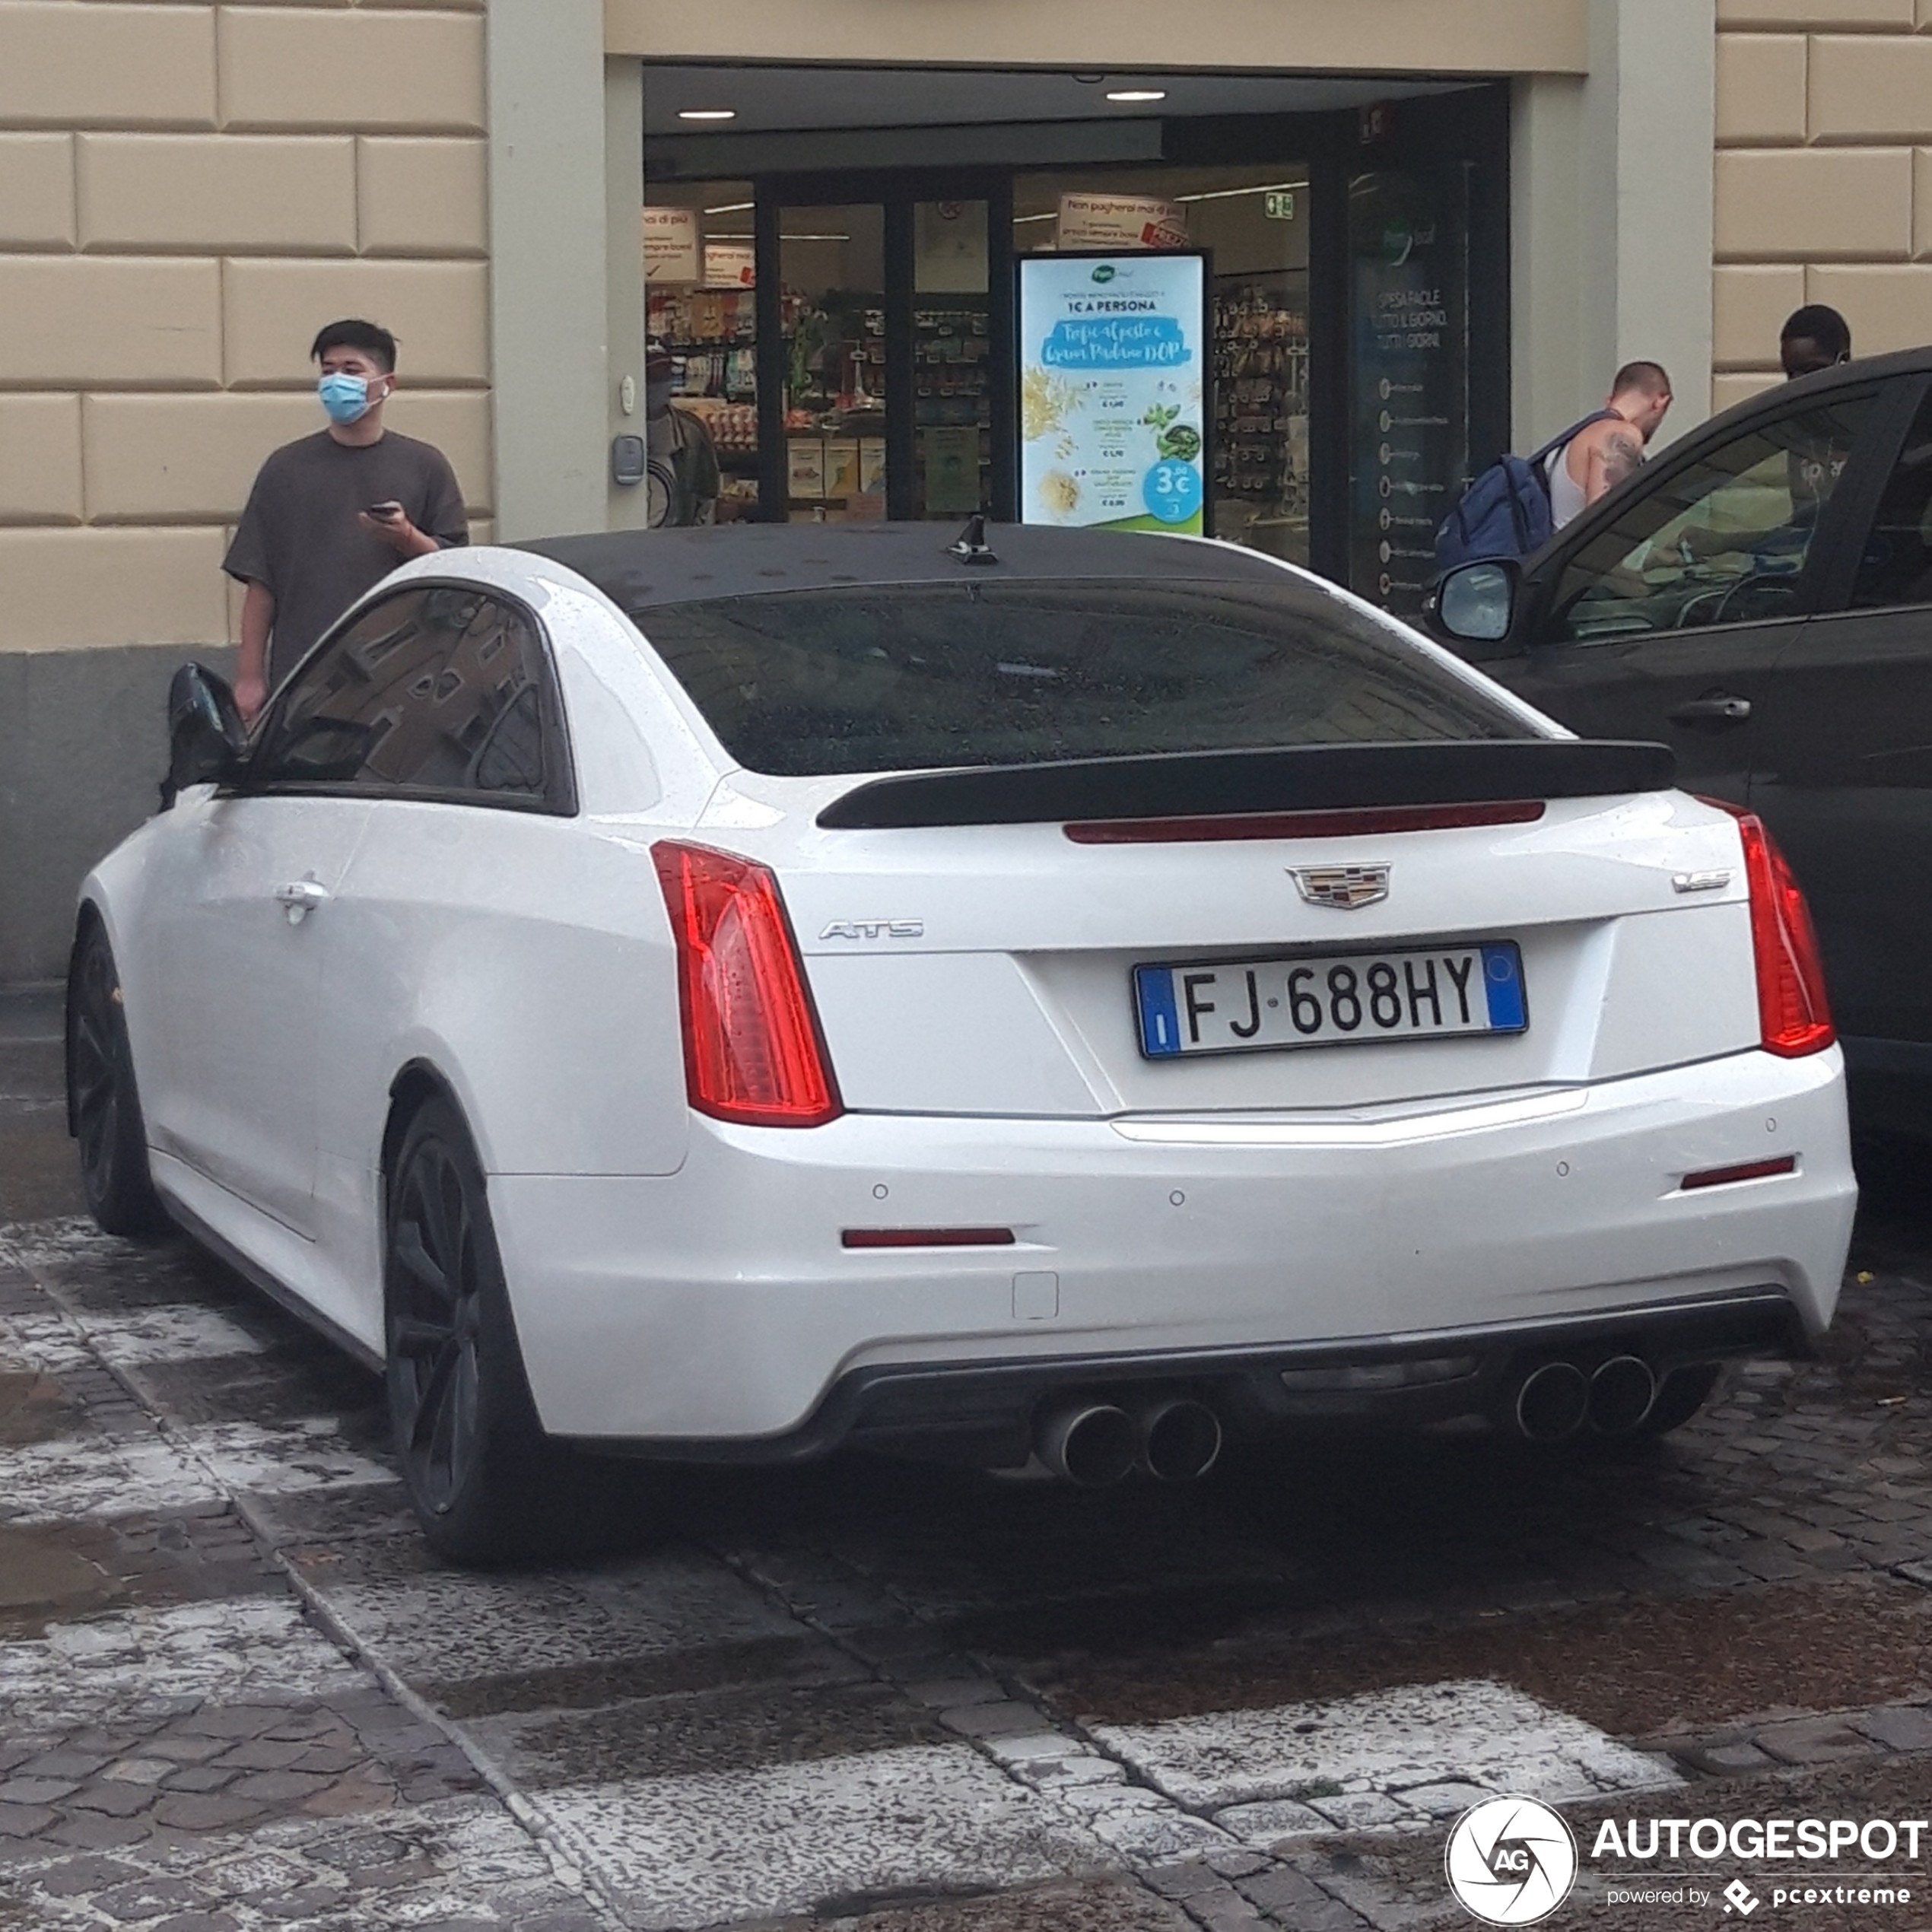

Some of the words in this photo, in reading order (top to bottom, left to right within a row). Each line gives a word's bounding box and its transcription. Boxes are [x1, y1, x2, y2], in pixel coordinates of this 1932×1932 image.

[1068, 200, 1088, 209] Non
[1091, 202, 1136, 214] pagherai
[1085, 302, 1094, 312] A
[1097, 300, 1156, 312] PERSONA
[1144, 341, 1180, 361] DOP
[818, 919, 923, 939] ATS
